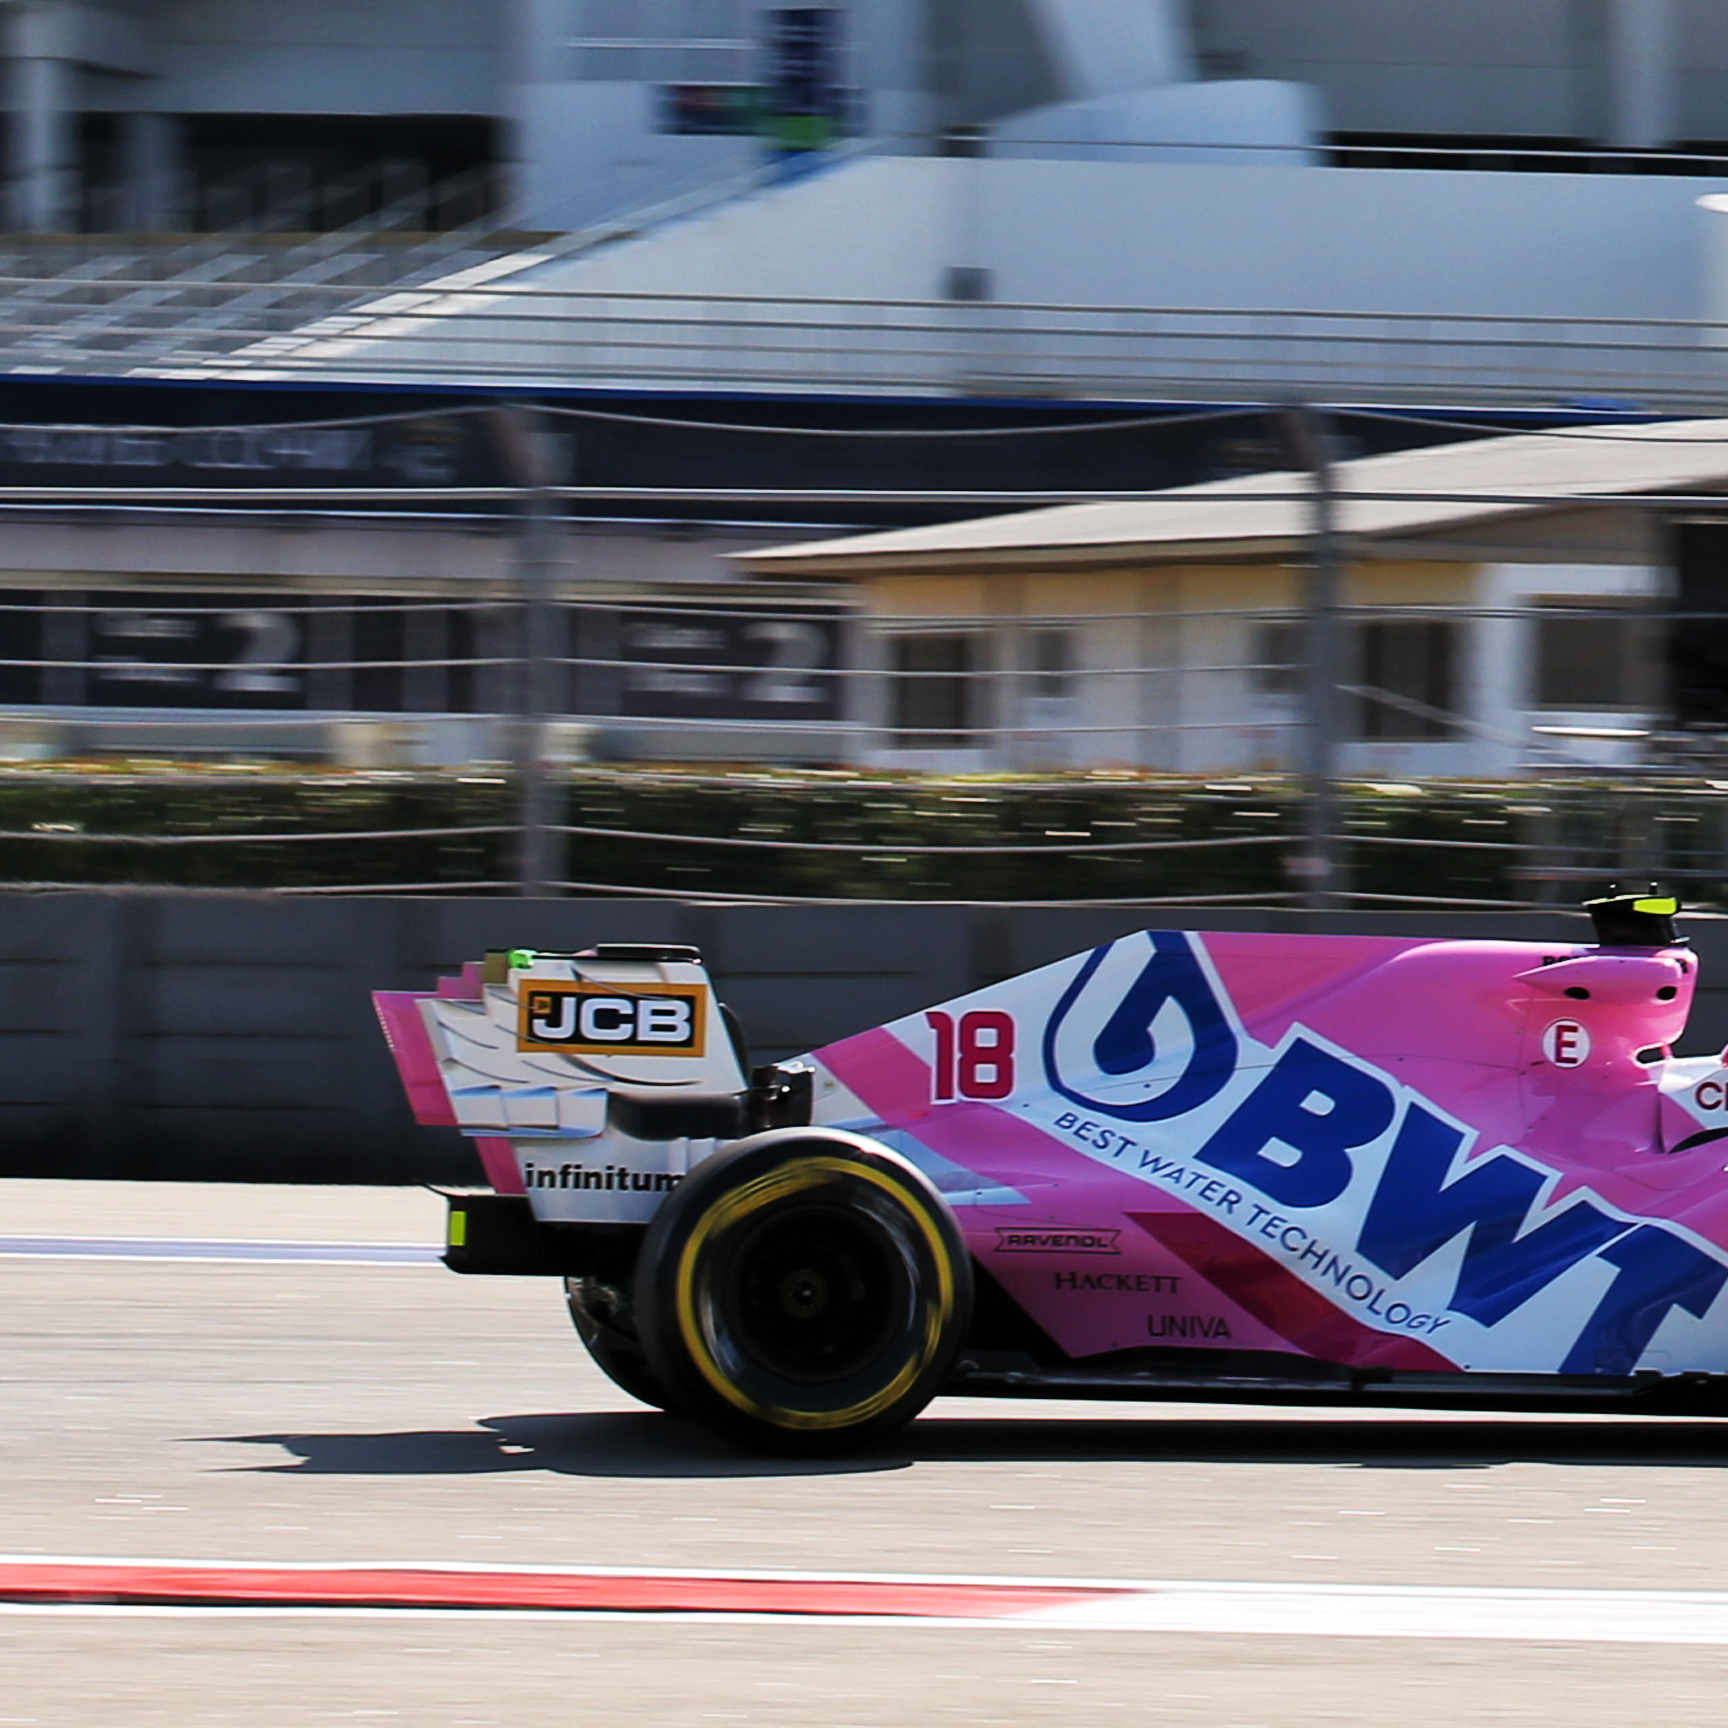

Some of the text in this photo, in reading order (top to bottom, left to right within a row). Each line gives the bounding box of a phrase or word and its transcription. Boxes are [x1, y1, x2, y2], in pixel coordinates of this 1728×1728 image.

[216, 612, 302, 692] 2
[742, 622, 830, 702] 2
[532, 996, 692, 1042] JCB
[927, 1010, 1016, 1103] 18
[1556, 1024, 1579, 1064] E
[525, 1162, 686, 1192] infinitum
[1007, 1233, 1109, 1249] RAVENOL
[1053, 1111, 1452, 1336] BEST WATER TECHNOLOGY
[1054, 1272, 1182, 1294] HACKETT
[1147, 1314, 1232, 1339] UNIVA
